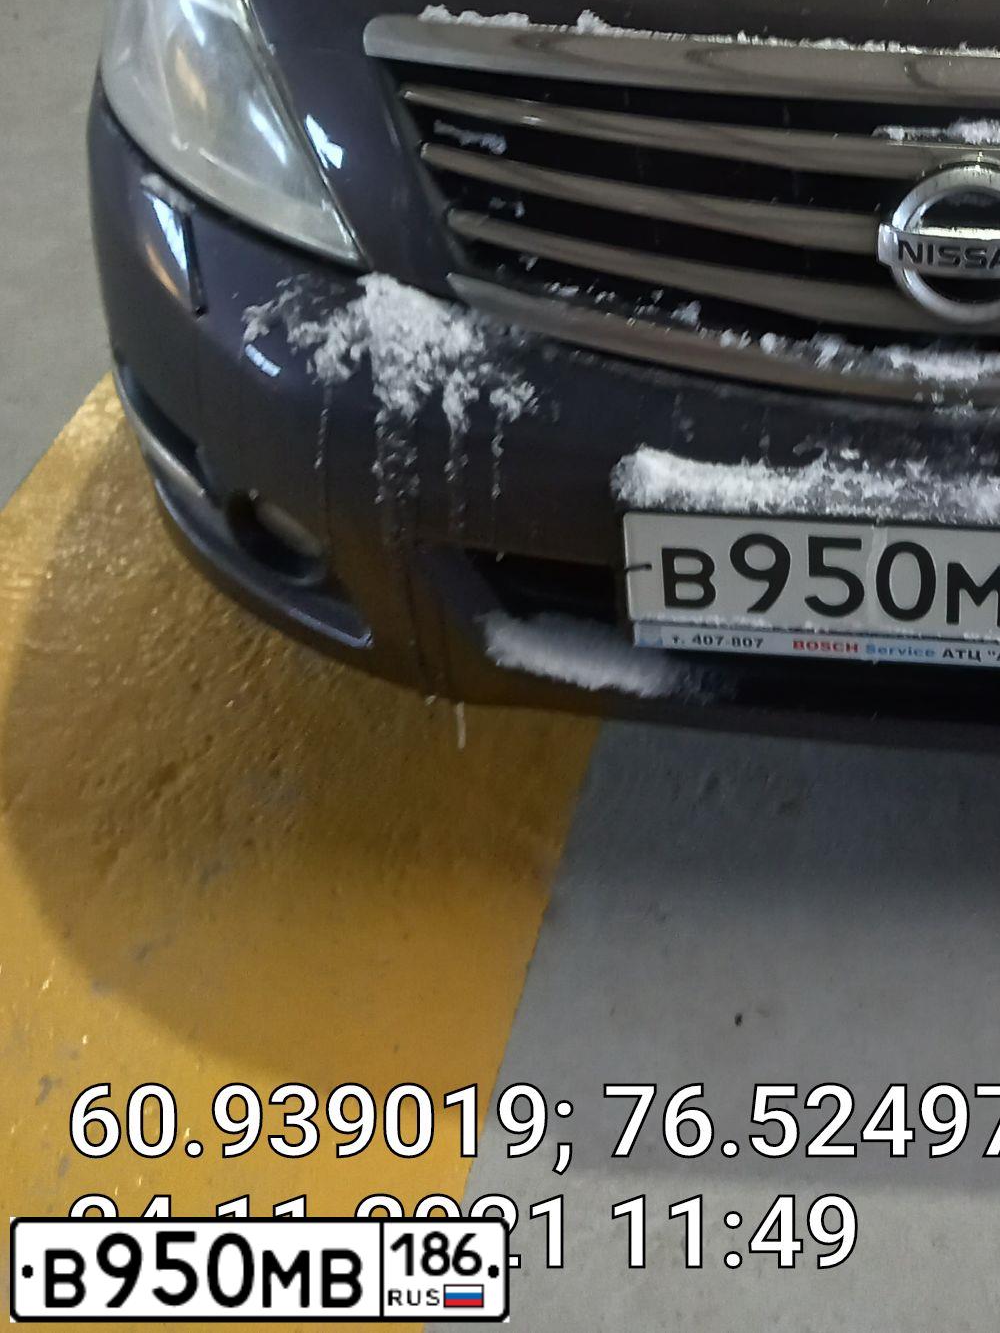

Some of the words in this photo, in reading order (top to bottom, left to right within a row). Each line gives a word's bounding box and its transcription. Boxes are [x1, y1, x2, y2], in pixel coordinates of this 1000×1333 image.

[692, 635, 763, 649] 407-807
[792, 639, 859, 654] BOSCH
[865, 644, 935, 658] Service
[942, 648, 982, 663] АТЦ
